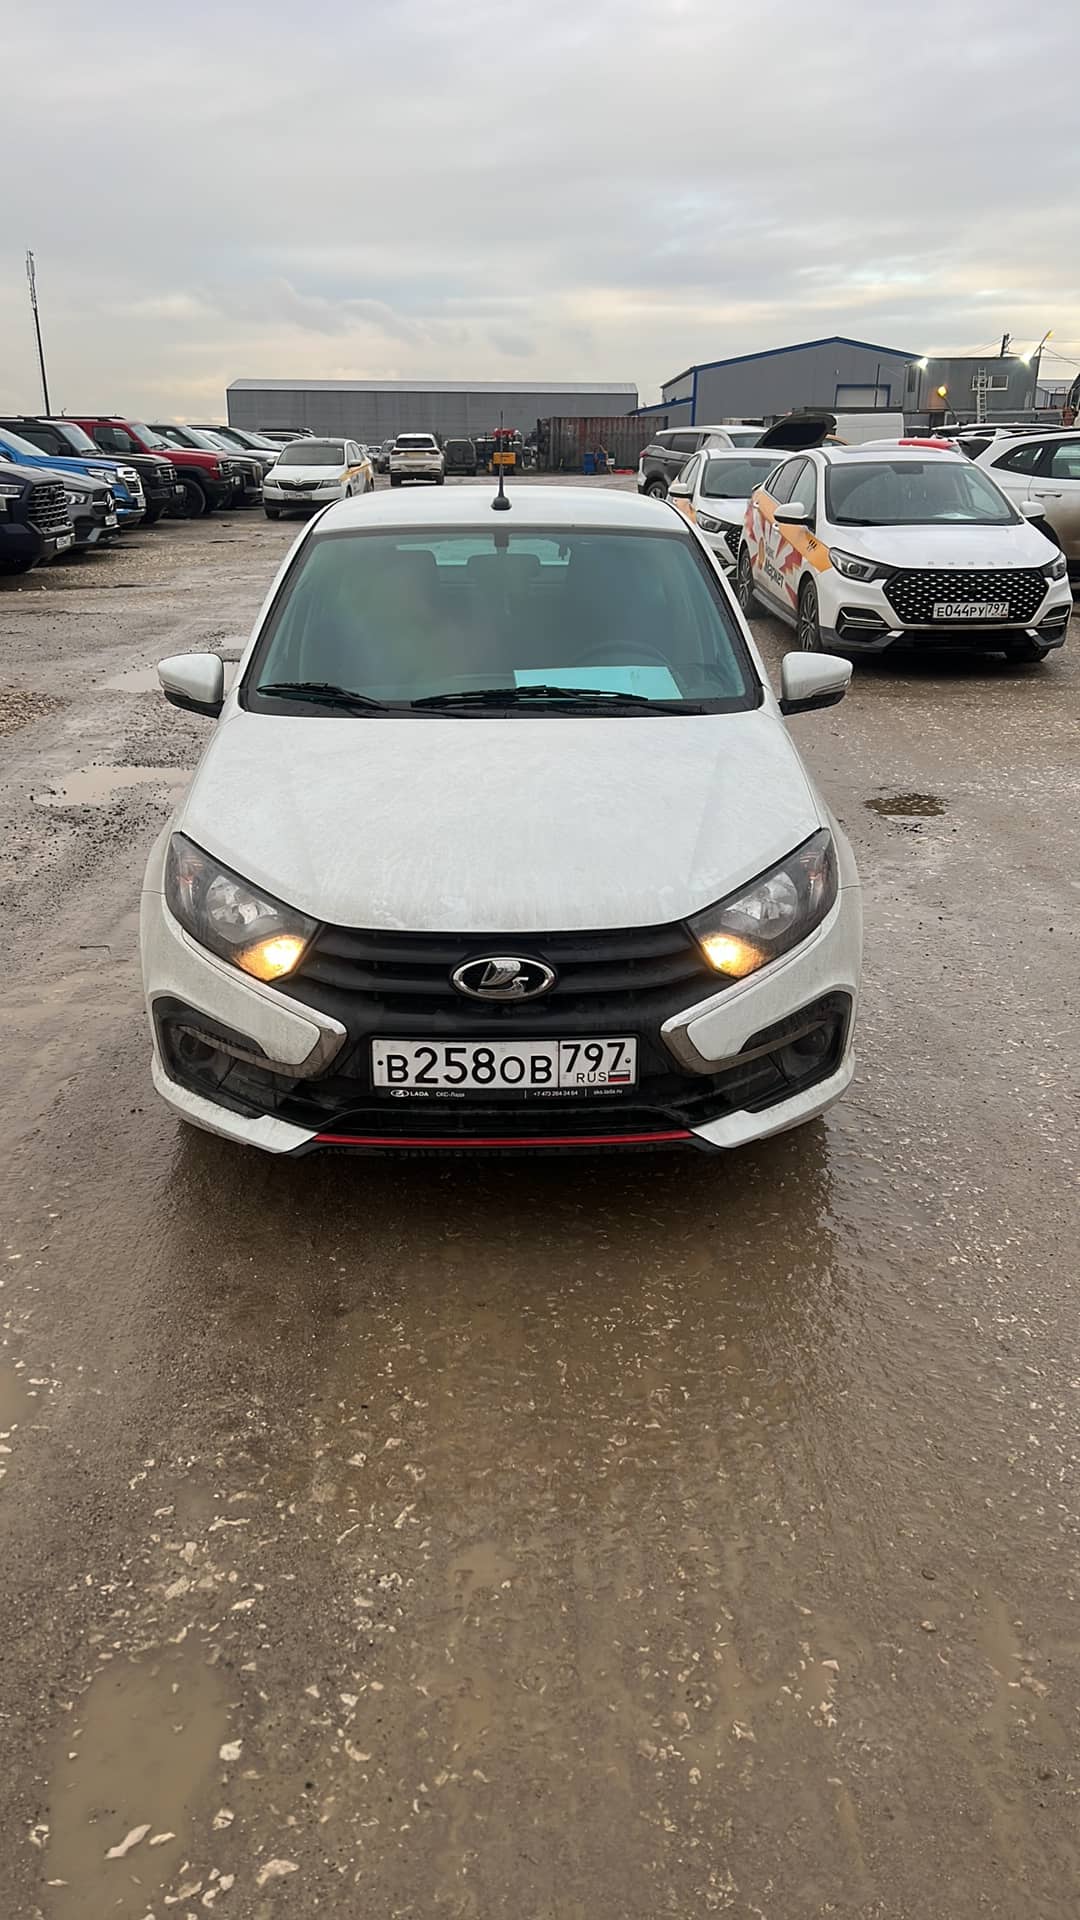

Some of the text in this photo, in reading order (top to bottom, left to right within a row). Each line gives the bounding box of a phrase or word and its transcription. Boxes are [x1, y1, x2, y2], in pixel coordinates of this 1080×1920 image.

[936, 603, 1006, 617] Е044РУ 797
[386, 1042, 626, 1084] В258ОВ 797
[576, 1072, 607, 1083] RUS
